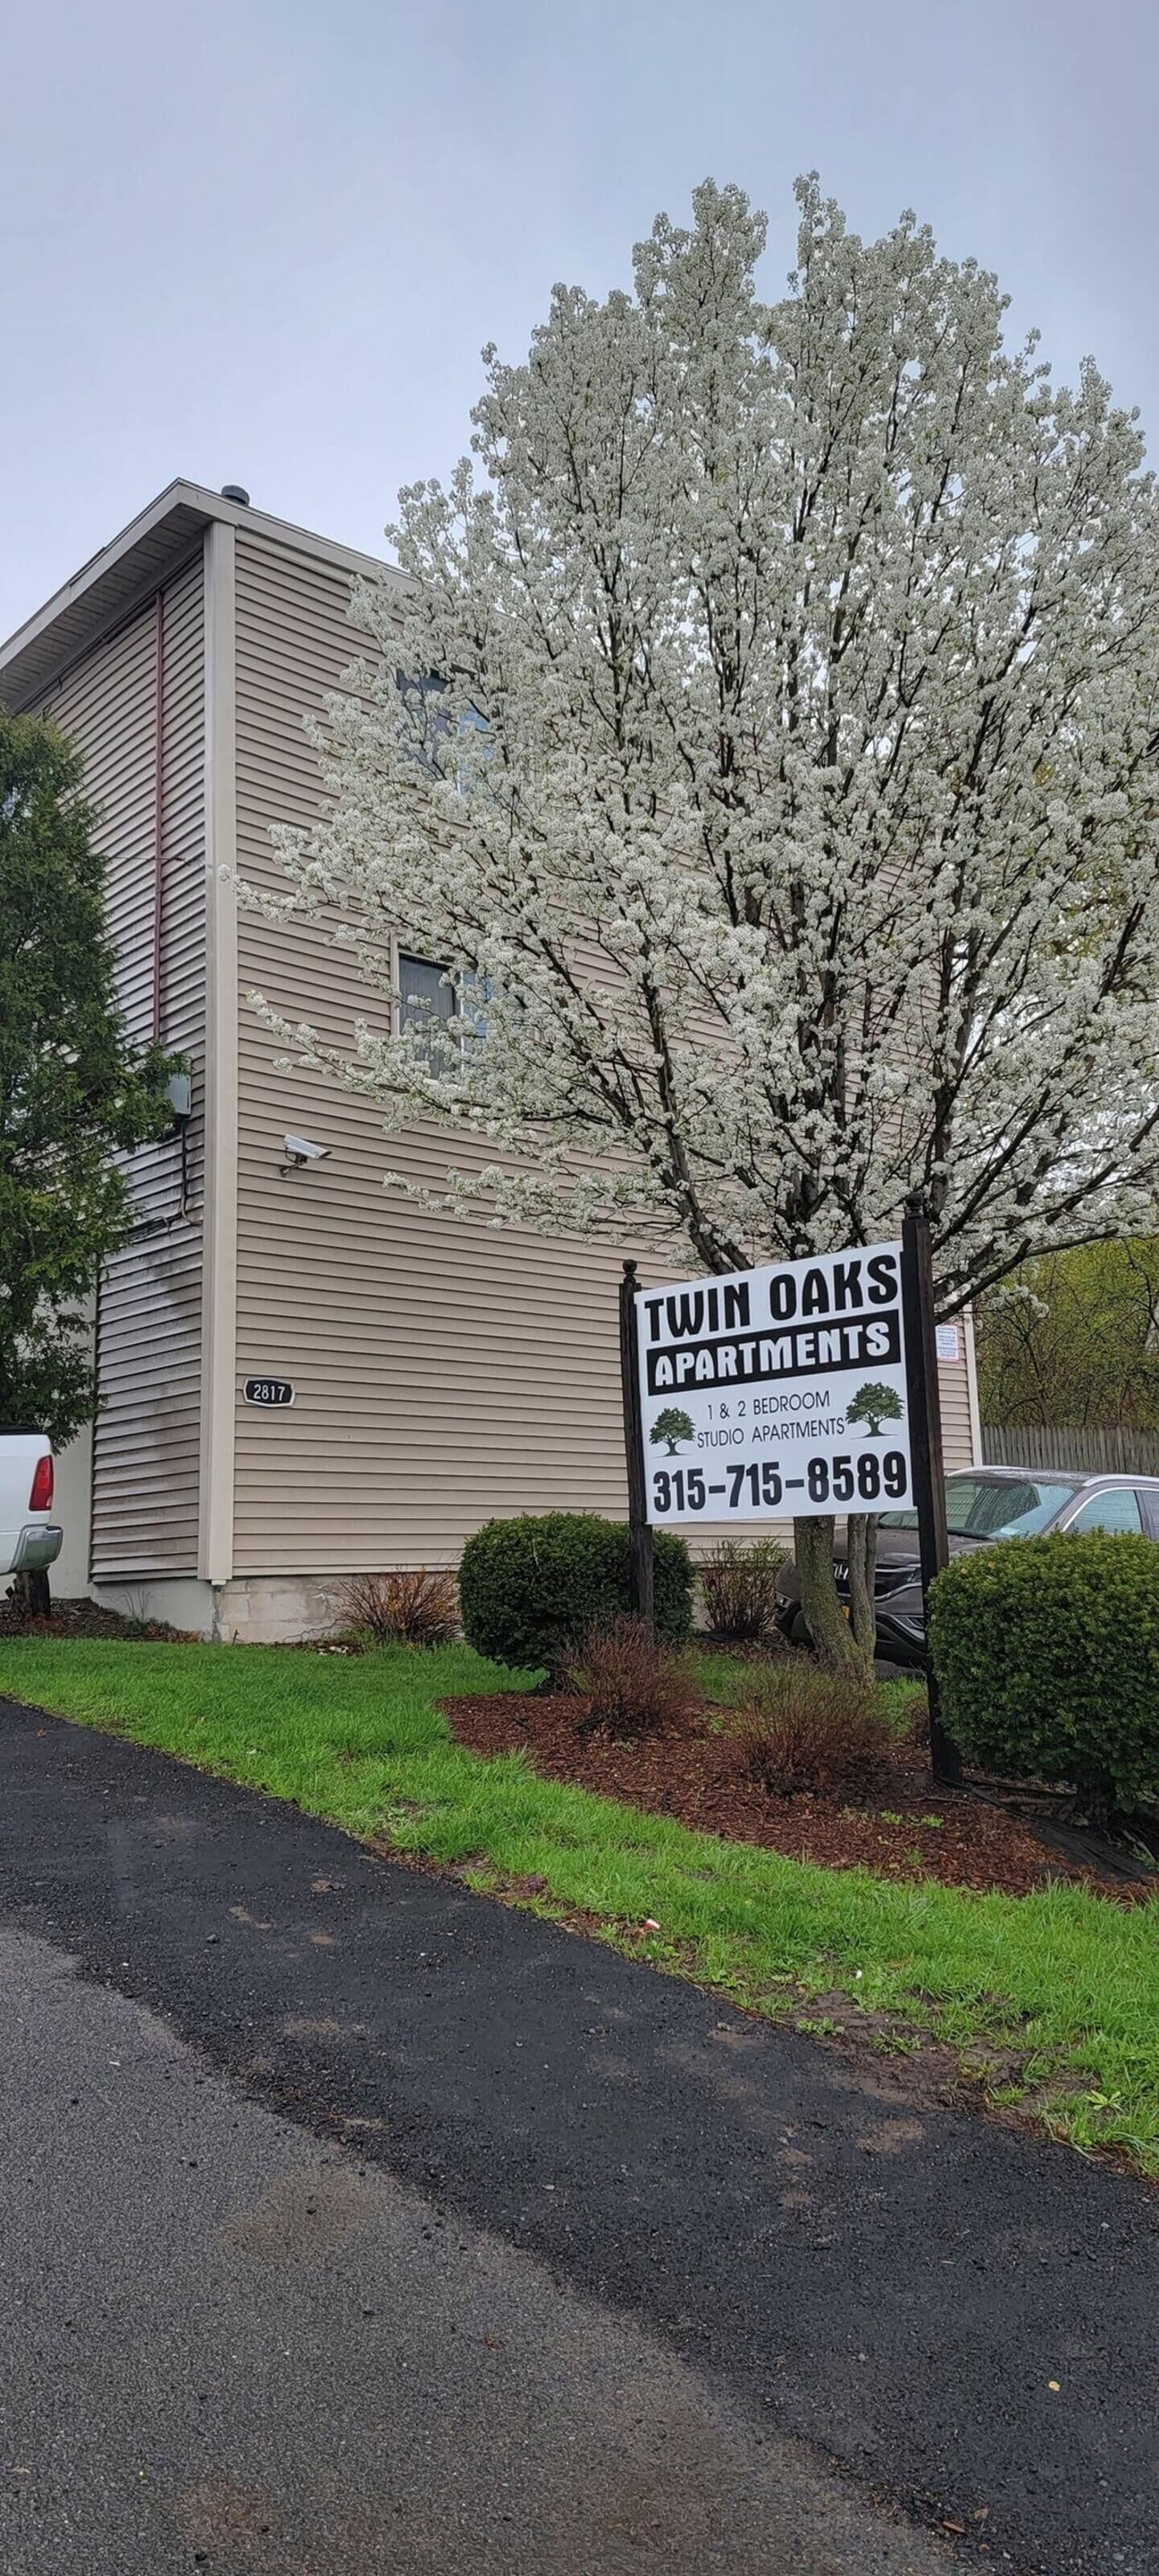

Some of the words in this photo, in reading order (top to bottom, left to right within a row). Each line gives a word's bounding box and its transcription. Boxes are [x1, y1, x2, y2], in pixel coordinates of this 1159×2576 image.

[645, 1282, 750, 1342] TWIN
[769, 1254, 897, 1320] OAKS
[654, 1321, 890, 1387] APARTMENTS
[253, 1384, 286, 1402] 2817
[707, 1404, 713, 1420] 1
[720, 1402, 730, 1418] &
[737, 1401, 746, 1417] 2
[753, 1390, 830, 1414] BEDROOM
[697, 1428, 744, 1448] STUDIO
[752, 1418, 845, 1443] APARTMENTS
[653, 1451, 907, 1513] 315-715-8589
